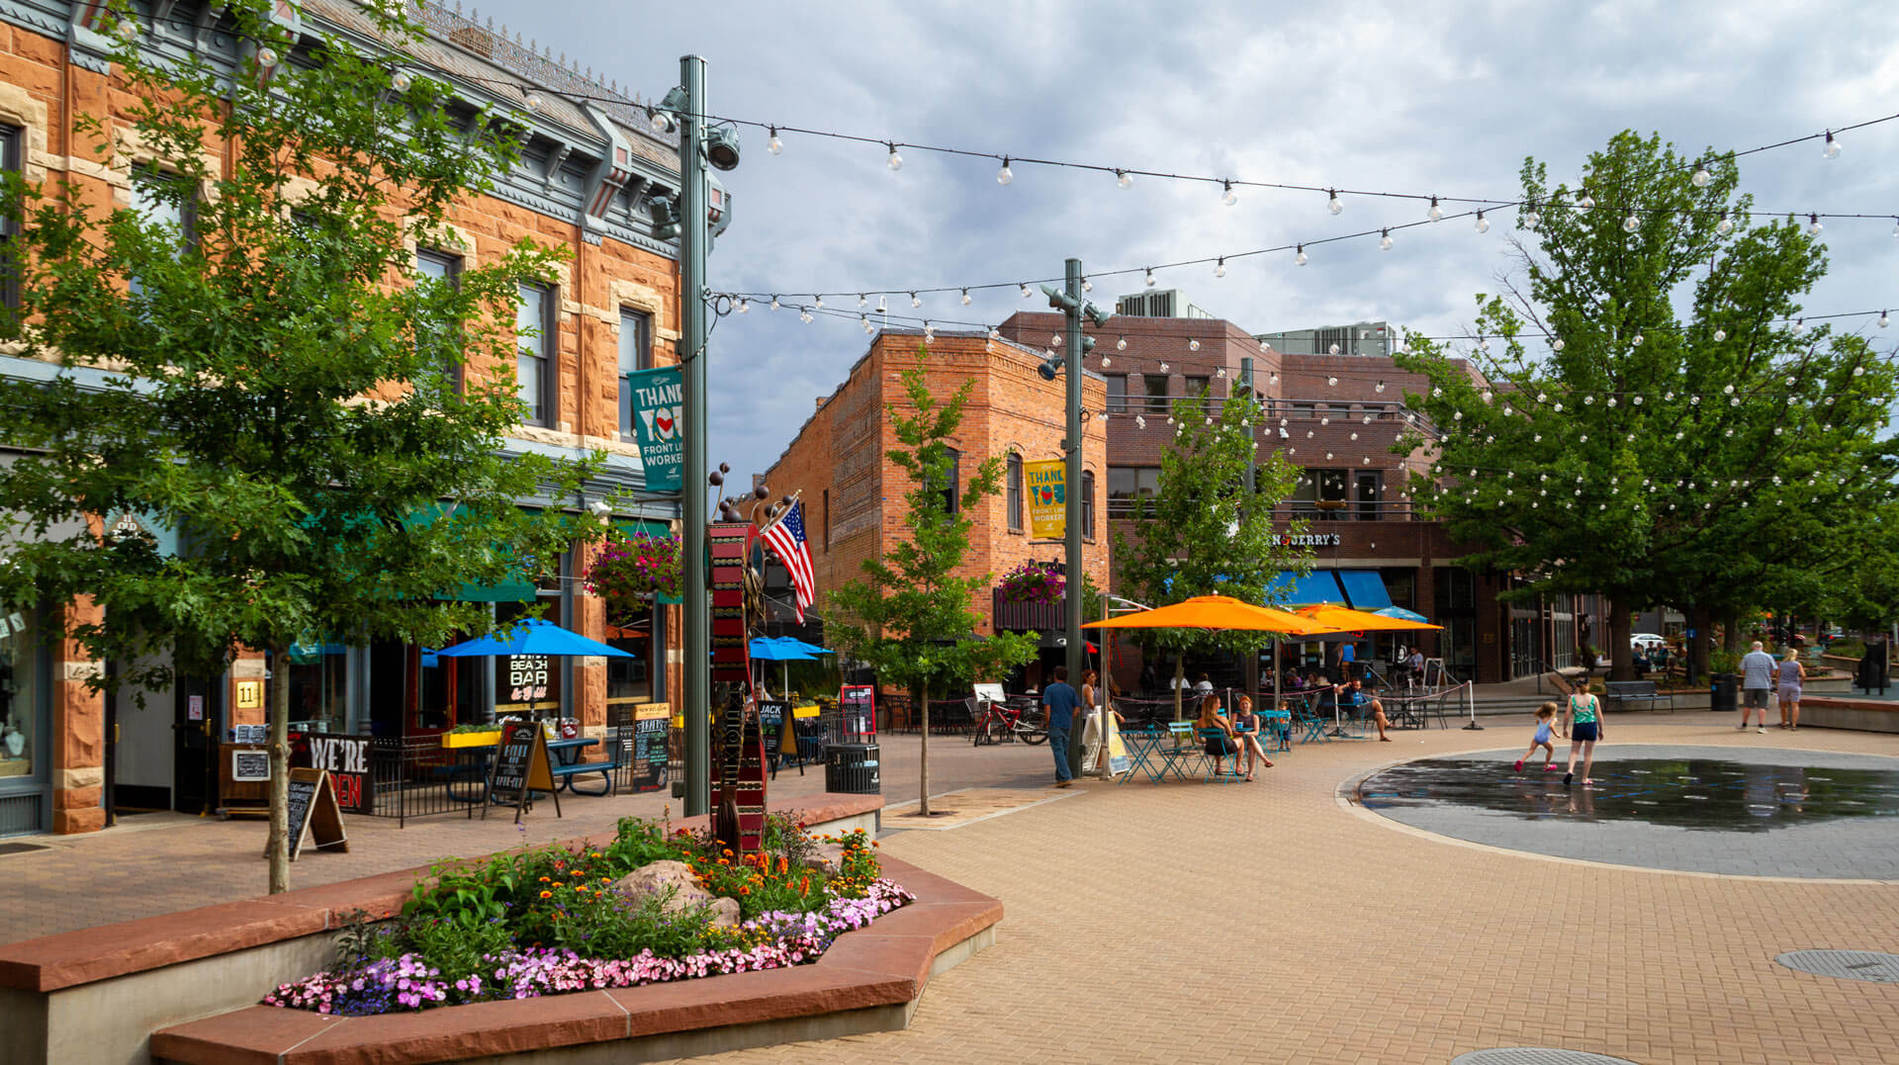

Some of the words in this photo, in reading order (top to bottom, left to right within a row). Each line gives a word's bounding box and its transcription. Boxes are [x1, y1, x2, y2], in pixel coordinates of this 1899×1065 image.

[636, 384, 682, 406] THANK
[644, 444, 673, 455] FRONT
[645, 454, 682, 466] WORKE
[1290, 533, 1340, 546] JERRY'S
[511, 660, 548, 670] BEACH
[511, 671, 548, 685] BAR
[239, 687, 253, 703] 11
[760, 704, 782, 714] JACK
[310, 737, 368, 773] WE'RE
[329, 773, 361, 808] PEN
